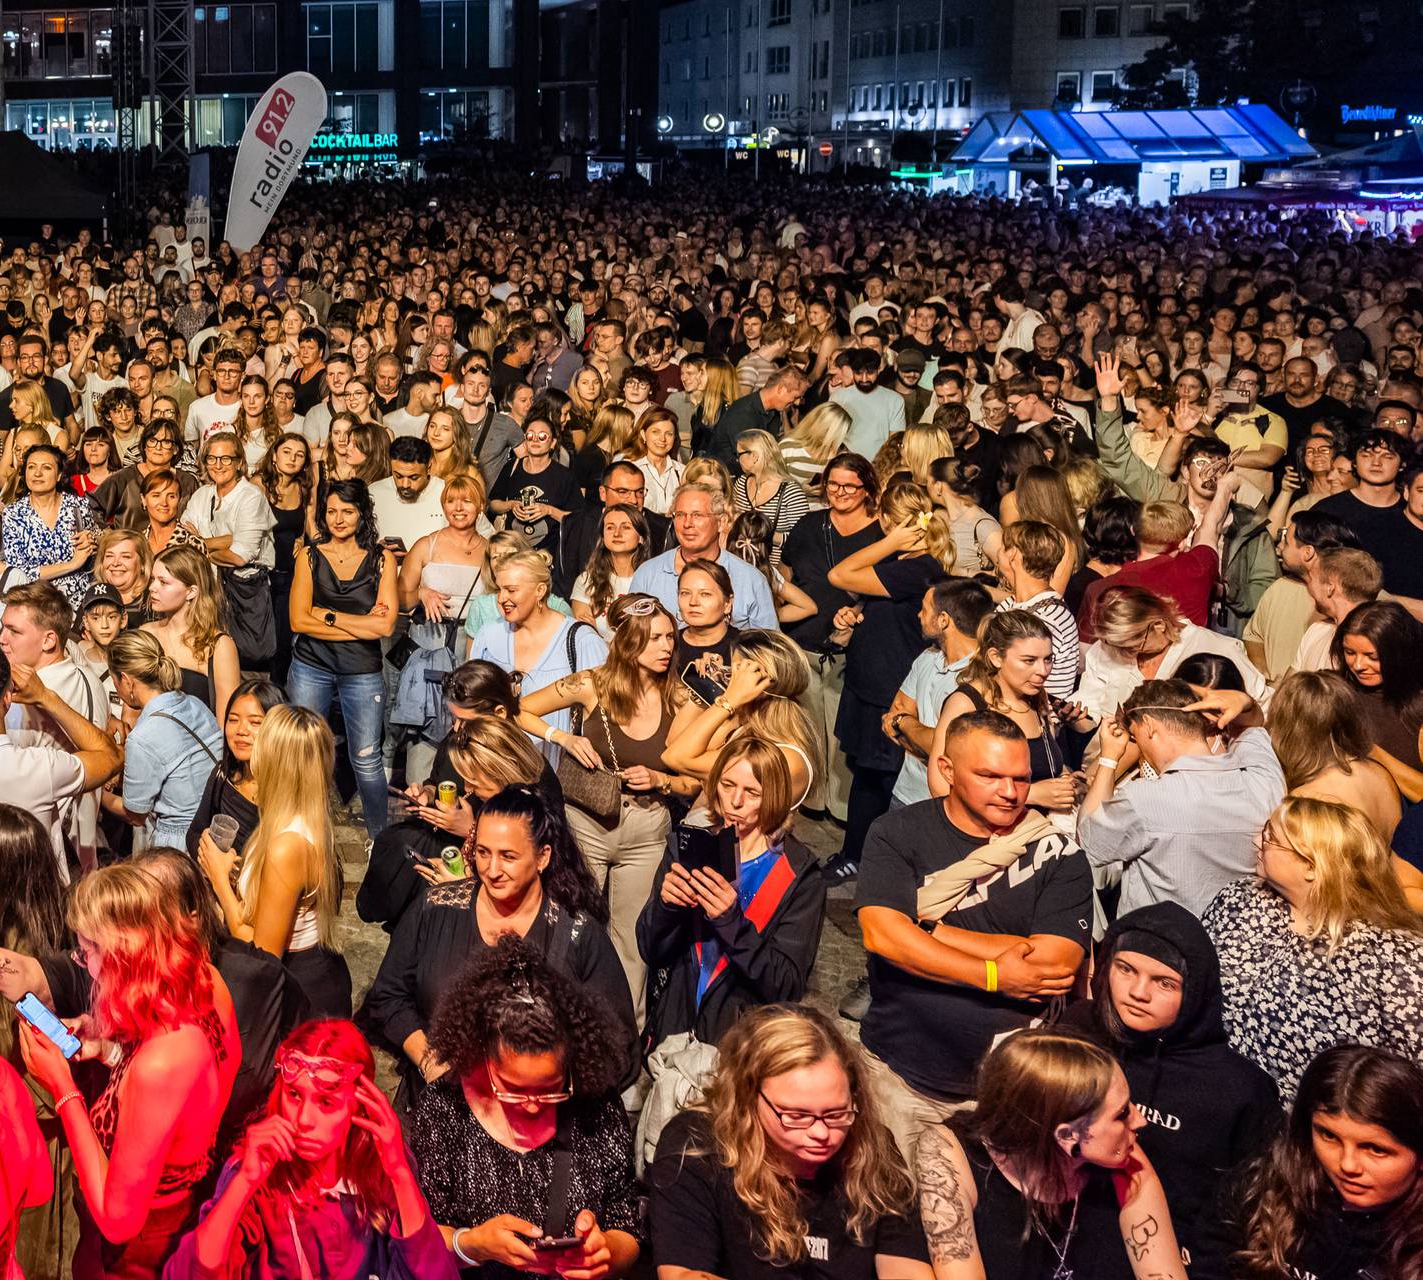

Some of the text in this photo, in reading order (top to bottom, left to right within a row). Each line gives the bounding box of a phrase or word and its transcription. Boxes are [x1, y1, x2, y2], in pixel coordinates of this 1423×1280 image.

[262, 93, 295, 136] 91.2
[249, 139, 293, 208] radio
[735, 151, 748, 160] WC
[777, 150, 790, 158] WC
[264, 148, 302, 213] MEIN DORTMUND
